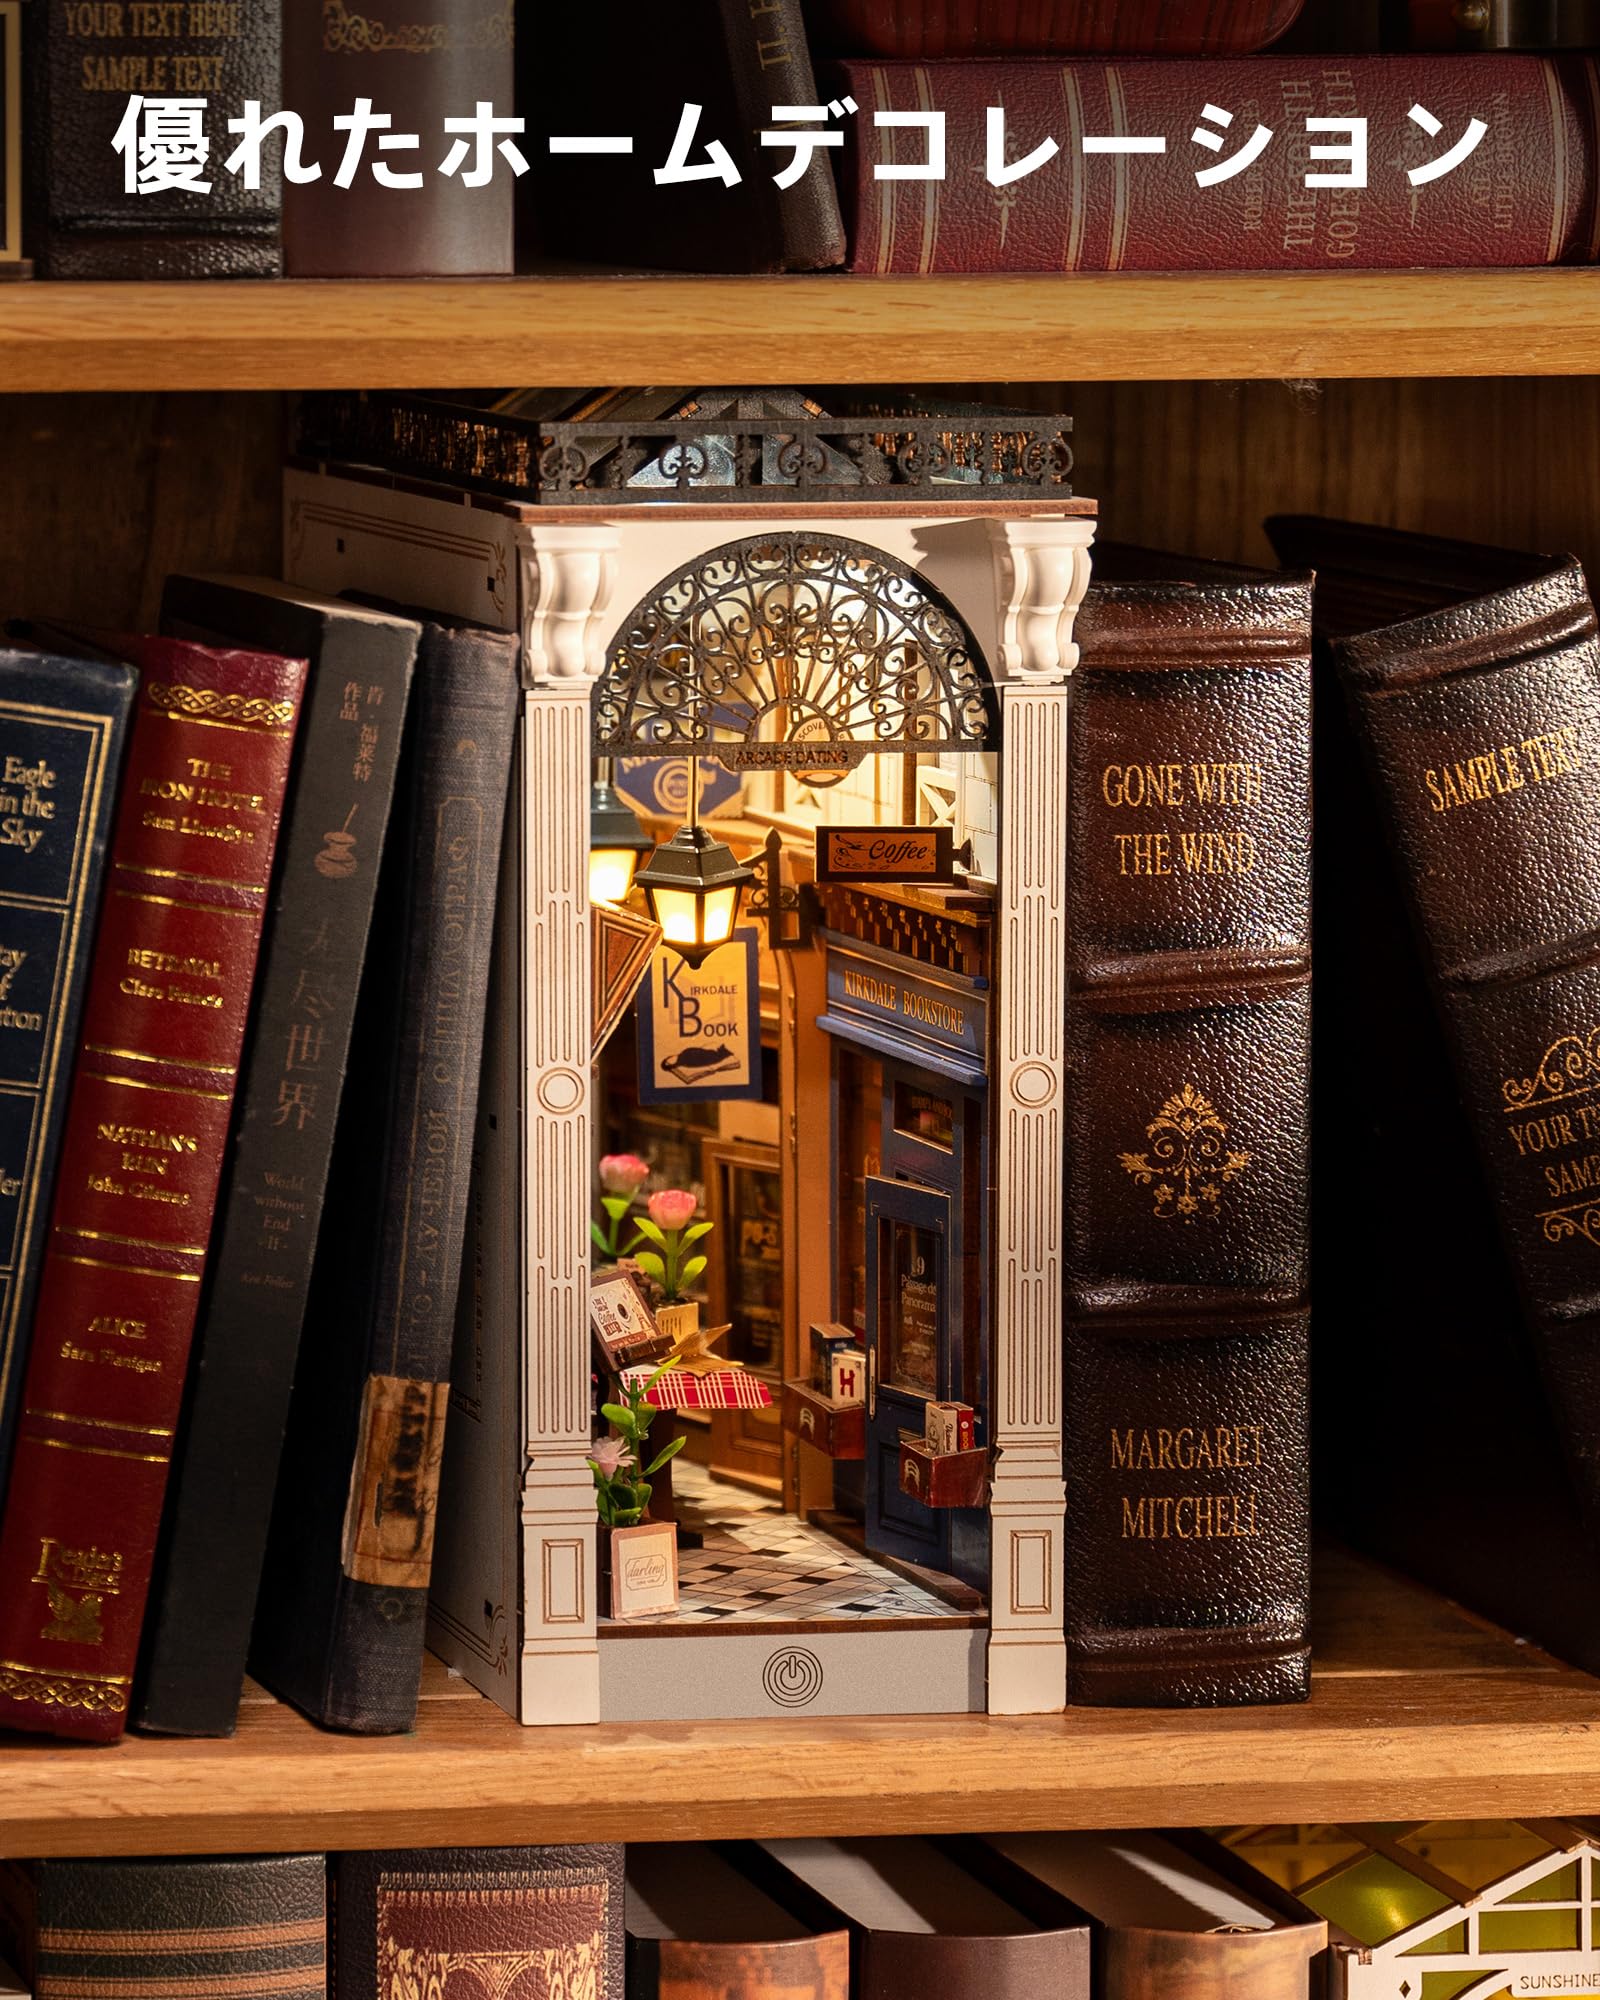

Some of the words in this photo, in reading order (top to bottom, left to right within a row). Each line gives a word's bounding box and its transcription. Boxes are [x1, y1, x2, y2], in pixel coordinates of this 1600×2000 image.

[64, 2, 122, 37] YOUR
[128, 2, 185, 37] TEXT
[81, 55, 168, 91] SAMPLE
[172, 56, 224, 91] TEXT
[1284, 192, 1316, 250] THE
[1325, 187, 1359, 258] GOES
[2, 755, 57, 789] Eagle
[735, 749, 799, 766] ARCADE
[800, 748, 850, 764] DATING
[1425, 746, 1526, 812] SAMPLE
[1521, 726, 1583, 784] TEXT
[1101, 763, 1184, 808] GONE
[1193, 762, 1264, 807] WITH
[22, 787, 57, 820] the
[0, 817, 44, 853] Sky
[868, 838, 929, 864] Coffee
[1115, 832, 1172, 876] THE
[1179, 831, 1257, 876] WIND
[844, 969, 897, 1011] KIRKDALE
[902, 989, 965, 1036] BOOKSTORE
[1508, 1112, 1578, 1155] YOUR
[87, 1316, 148, 1340] ALICE
[839, 1368, 856, 1398] H
[1109, 1424, 1266, 1471] MARGARET
[1120, 1493, 1266, 1540] MITCHELL
[1520, 1972, 1600, 1990] SUNSHINE
